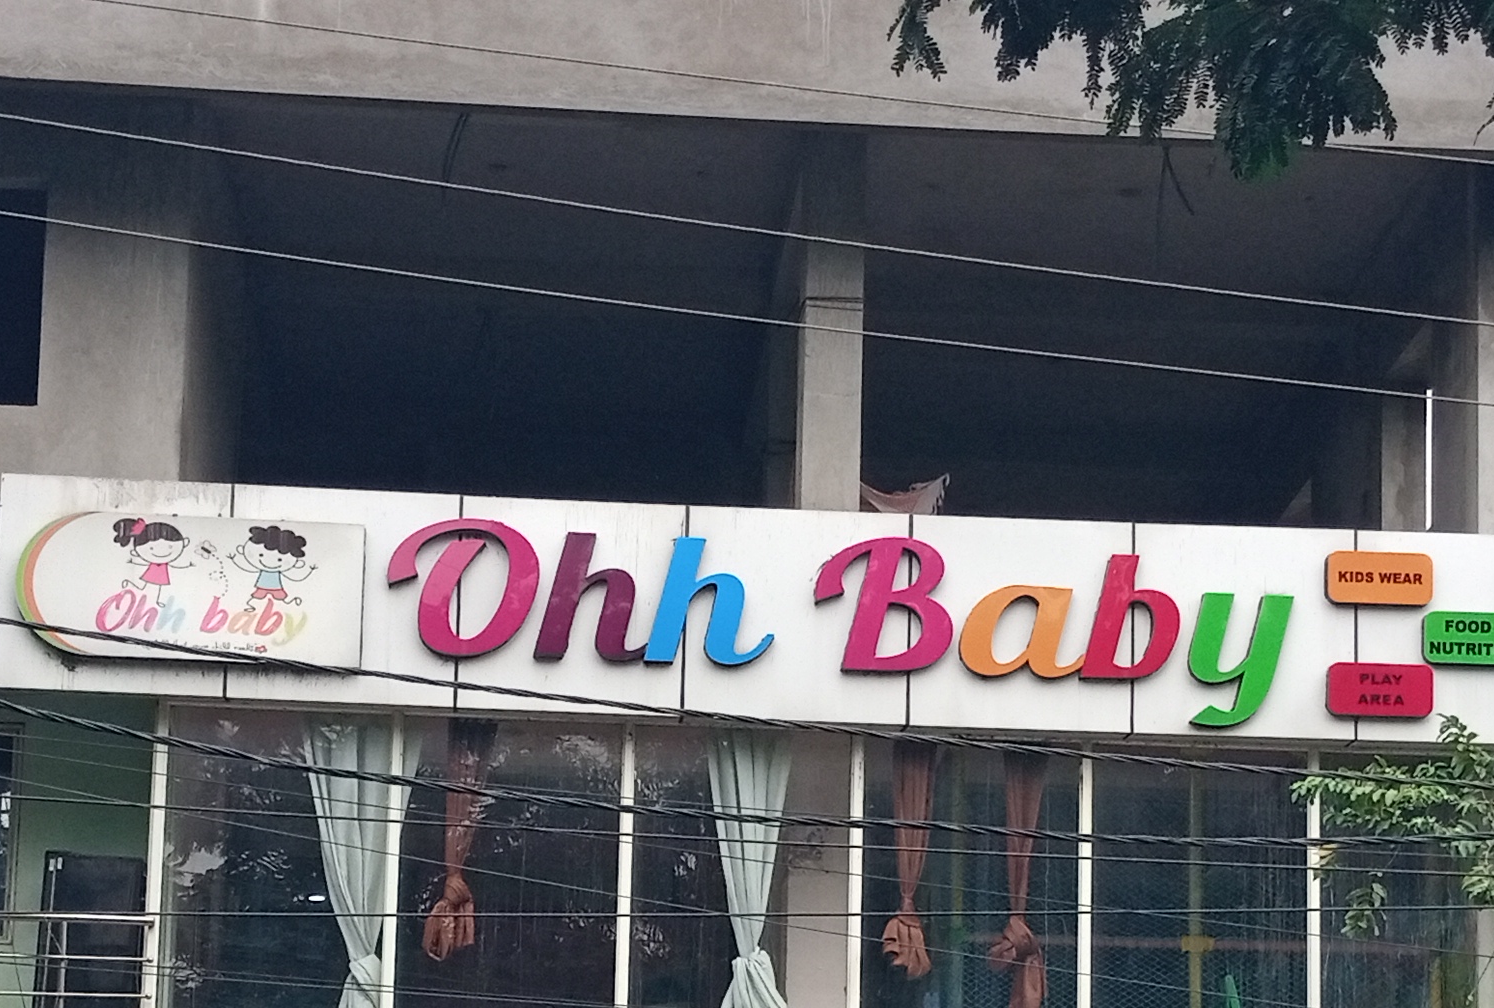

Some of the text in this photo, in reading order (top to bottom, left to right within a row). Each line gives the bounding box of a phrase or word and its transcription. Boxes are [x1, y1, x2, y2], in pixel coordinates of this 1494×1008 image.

[1338, 571, 1423, 585] KIDS WEAR
[95, 589, 307, 646] Ohh baby
[388, 518, 1294, 729] Ohh Baby
[1444, 620, 1491, 634] FOOD
[1359, 673, 1402, 686] PLAY
[1359, 694, 1404, 706] AREA
